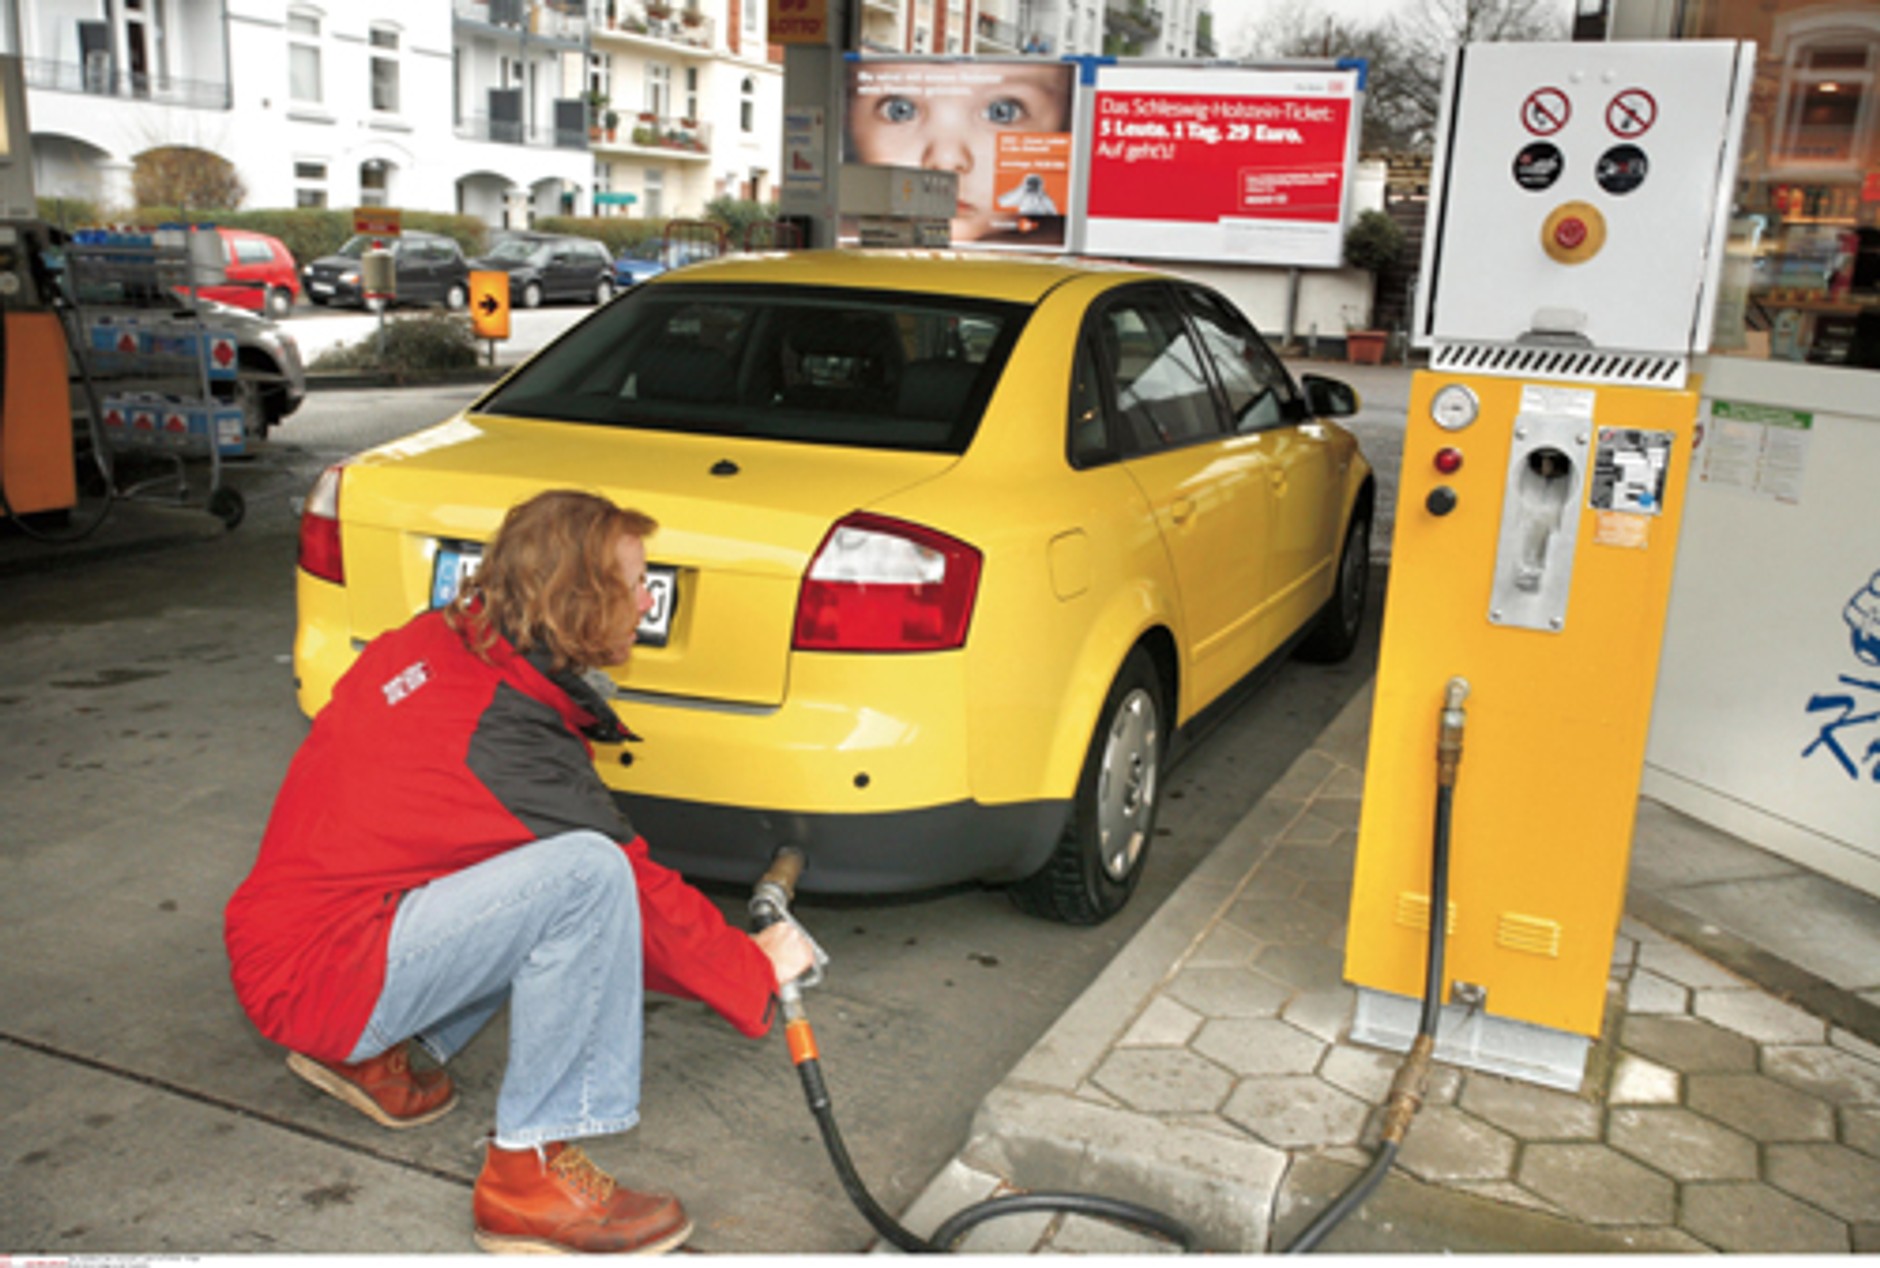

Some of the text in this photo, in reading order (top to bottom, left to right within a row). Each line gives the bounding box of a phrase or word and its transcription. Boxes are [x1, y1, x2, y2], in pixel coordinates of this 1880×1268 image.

[769, 18, 821, 35] LOTTO
[1101, 98, 1335, 121] Das Schleswig-Holstein-Ticket:
[1100, 120, 1304, 144] 5 Leute. 1 Tag. 29 Euro.
[1097, 141, 1123, 159] Auf
